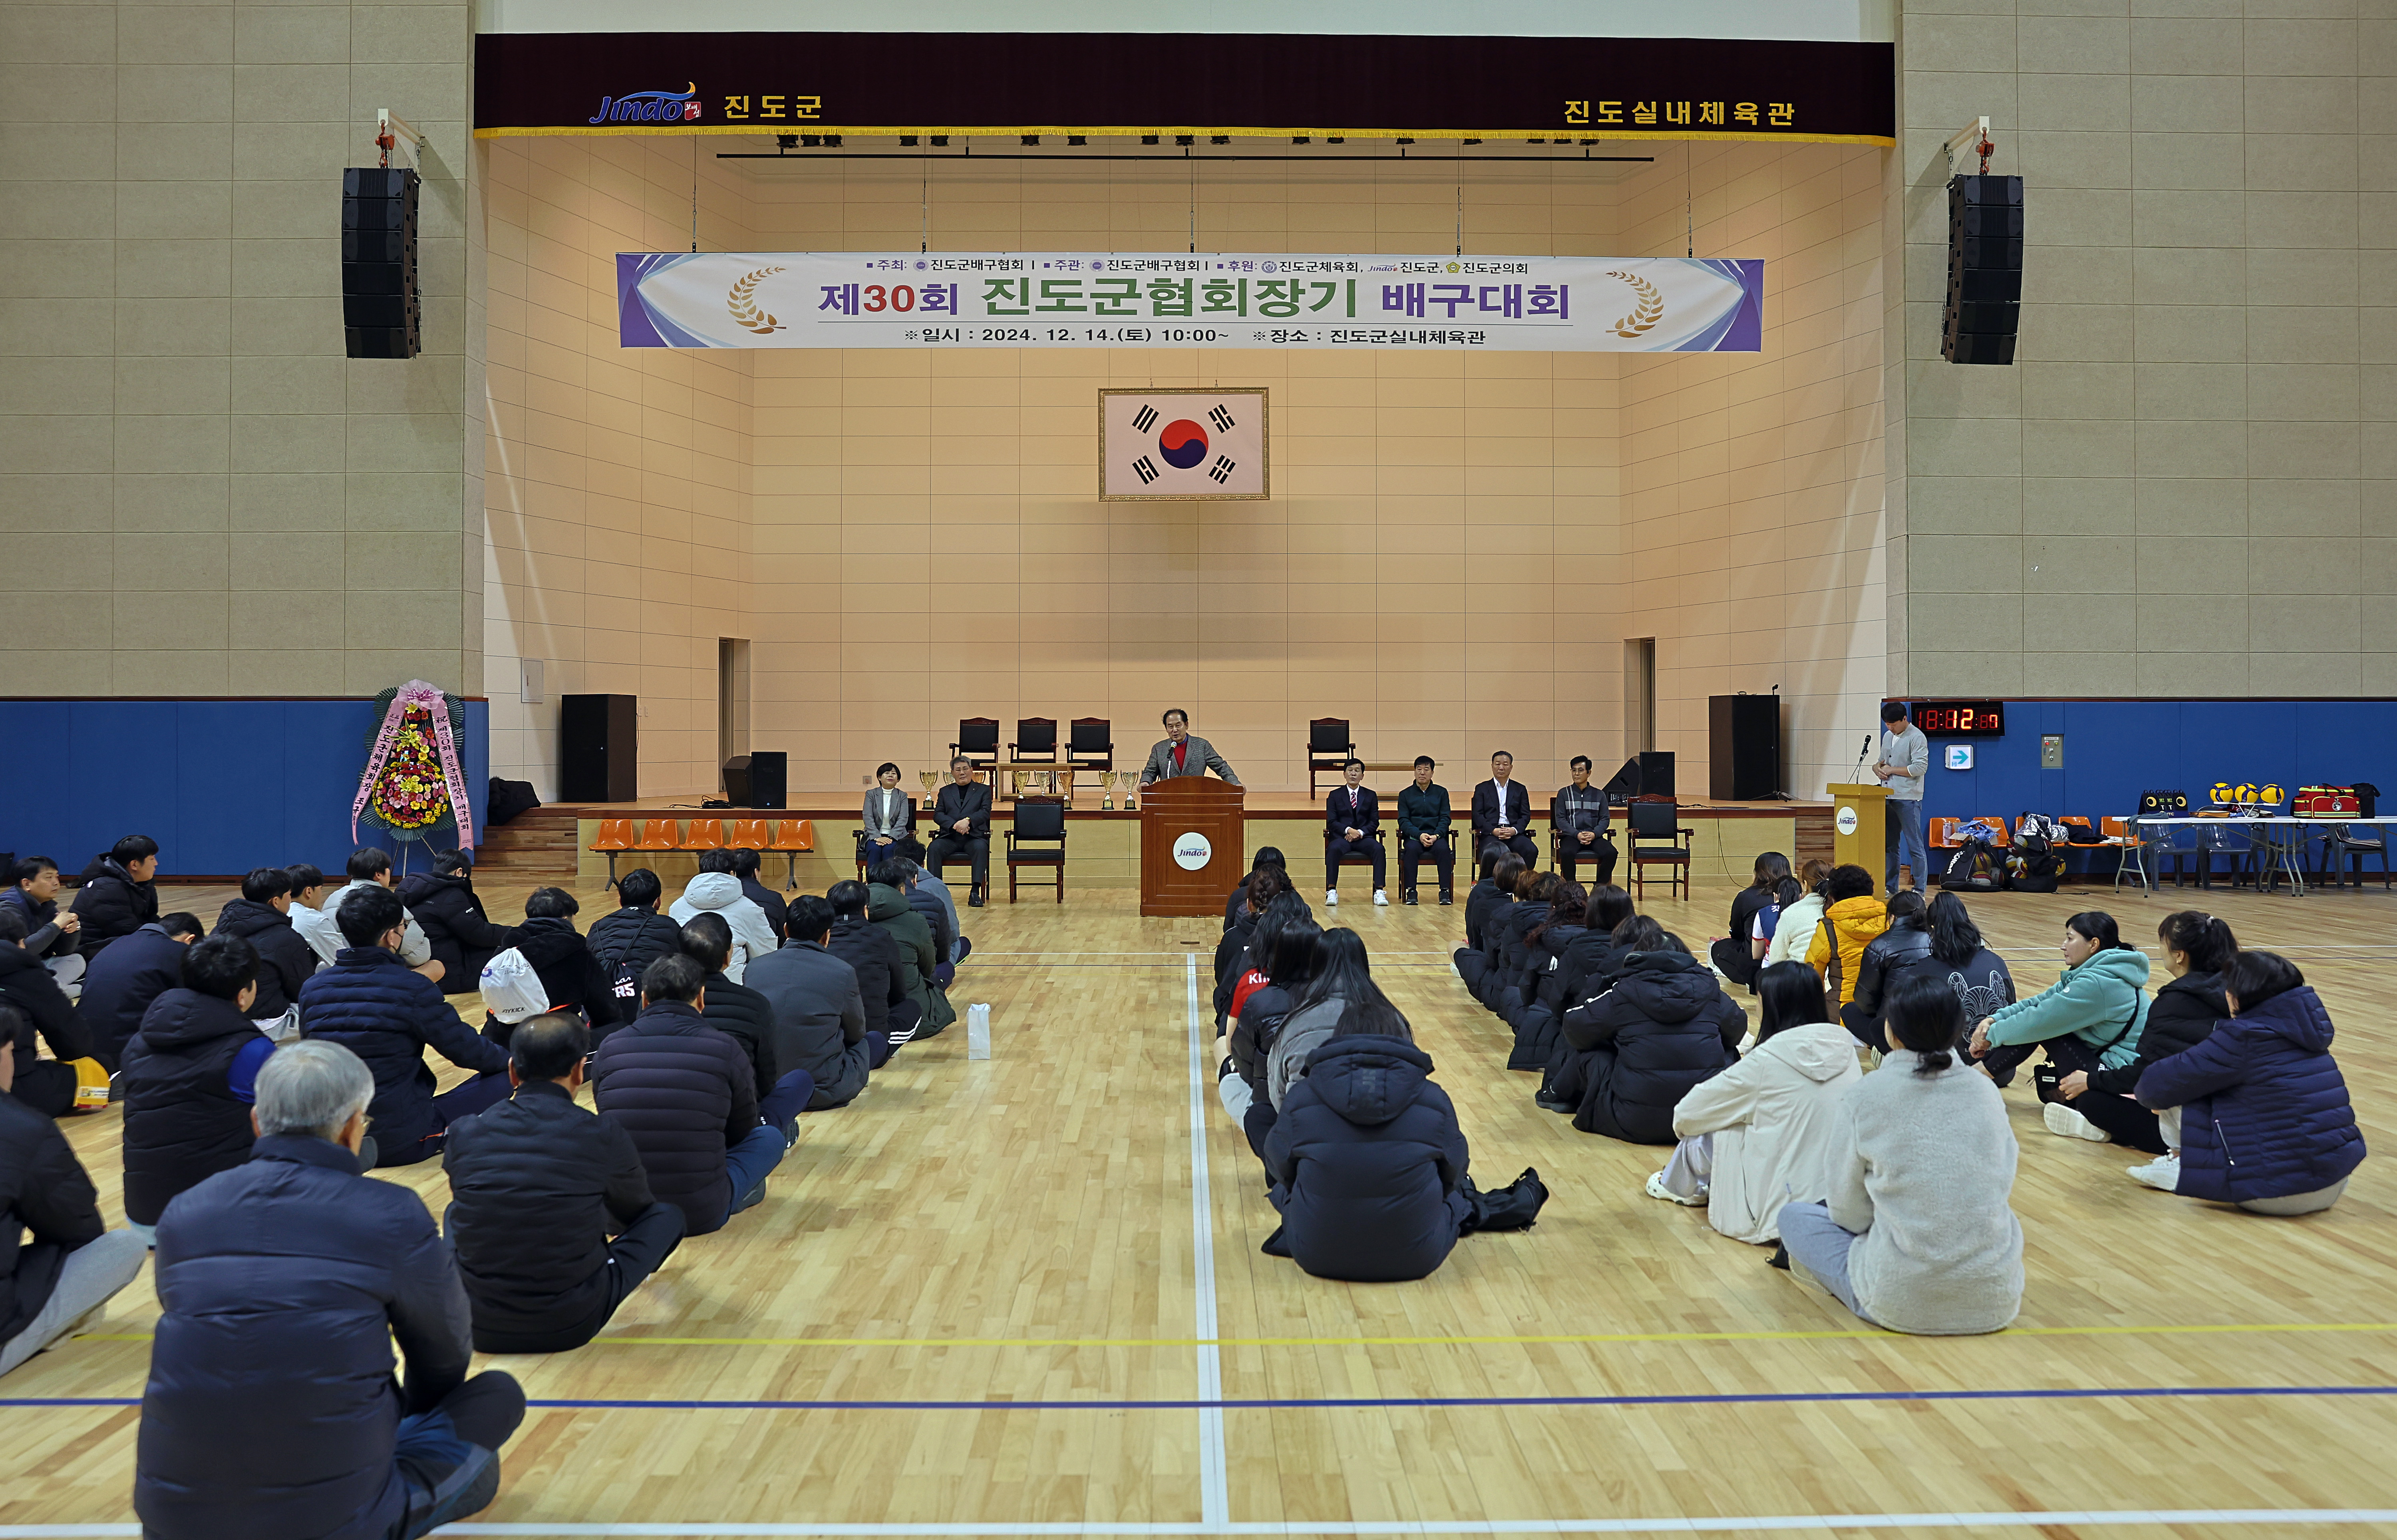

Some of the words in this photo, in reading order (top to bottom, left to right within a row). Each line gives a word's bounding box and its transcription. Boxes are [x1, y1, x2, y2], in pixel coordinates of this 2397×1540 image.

[589, 97, 683, 123] Jindo
[724, 95, 821, 119] 진도군
[1564, 101, 1795, 126] 진도실내체육관
[877, 260, 907, 271] 주최:
[930, 259, 1024, 271] 진도군배구협회
[1054, 260, 1084, 271] 주관:
[1107, 260, 1199, 272] 진도군배구협회
[1227, 261, 1257, 272] 후원:
[1279, 261, 1363, 273] 진도군체육회,
[1400, 262, 1443, 274] 진도군,
[1463, 262, 1528, 274] 진도군의회
[818, 283, 958, 316] 제30회
[981, 277, 1356, 318] 진도군협회장기
[1382, 283, 1568, 320] 배구대회
[982, 329, 1038, 341] 2024.
[1047, 329, 1075, 341] 12.
[1085, 327, 1152, 343] 14.(토)
[1330, 329, 1486, 344] 진도군실내체육관
[437, 726, 451, 751] 제30회
[362, 725, 394, 792] 진도군체육회장
[443, 754, 463, 800] 진도군협회장기
[456, 804, 469, 830] 배구대회
